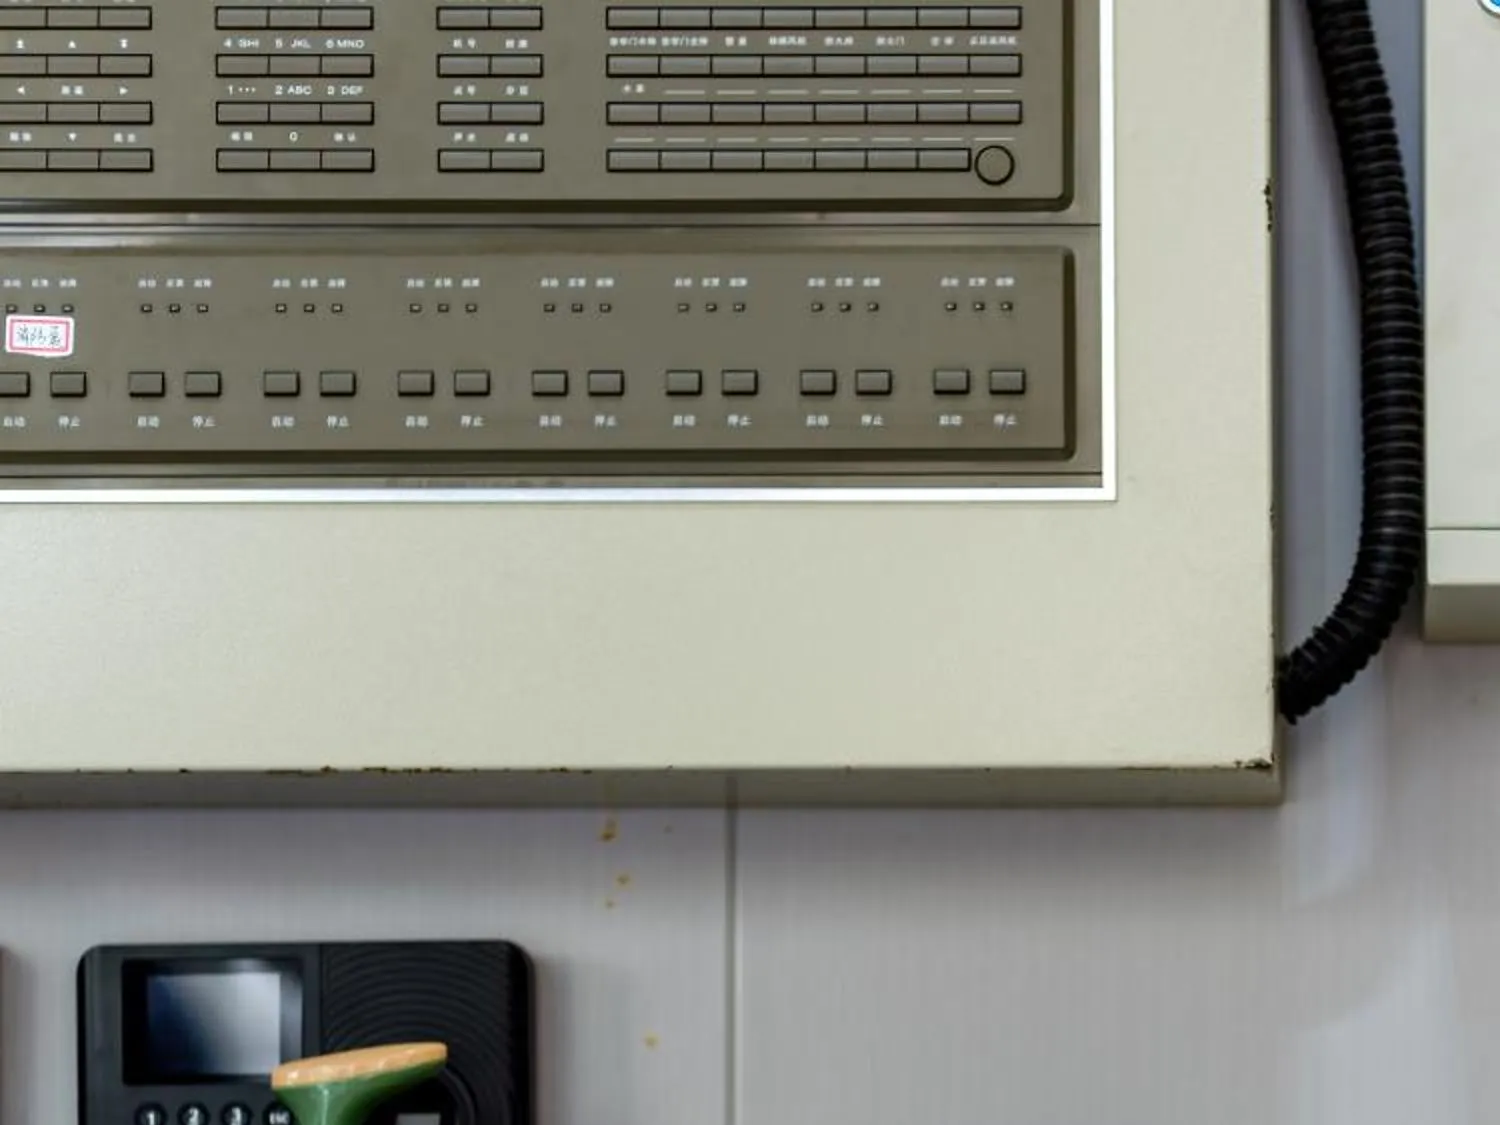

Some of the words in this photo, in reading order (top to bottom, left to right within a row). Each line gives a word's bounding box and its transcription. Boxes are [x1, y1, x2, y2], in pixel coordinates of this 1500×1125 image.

[223, 37, 233, 49] 4
[336, 38, 366, 49] MNO
[227, 84, 234, 96] 1
[274, 84, 284, 96] 2
[286, 84, 313, 96] ABC
[327, 84, 336, 96] 3
[340, 85, 364, 96] DEF
